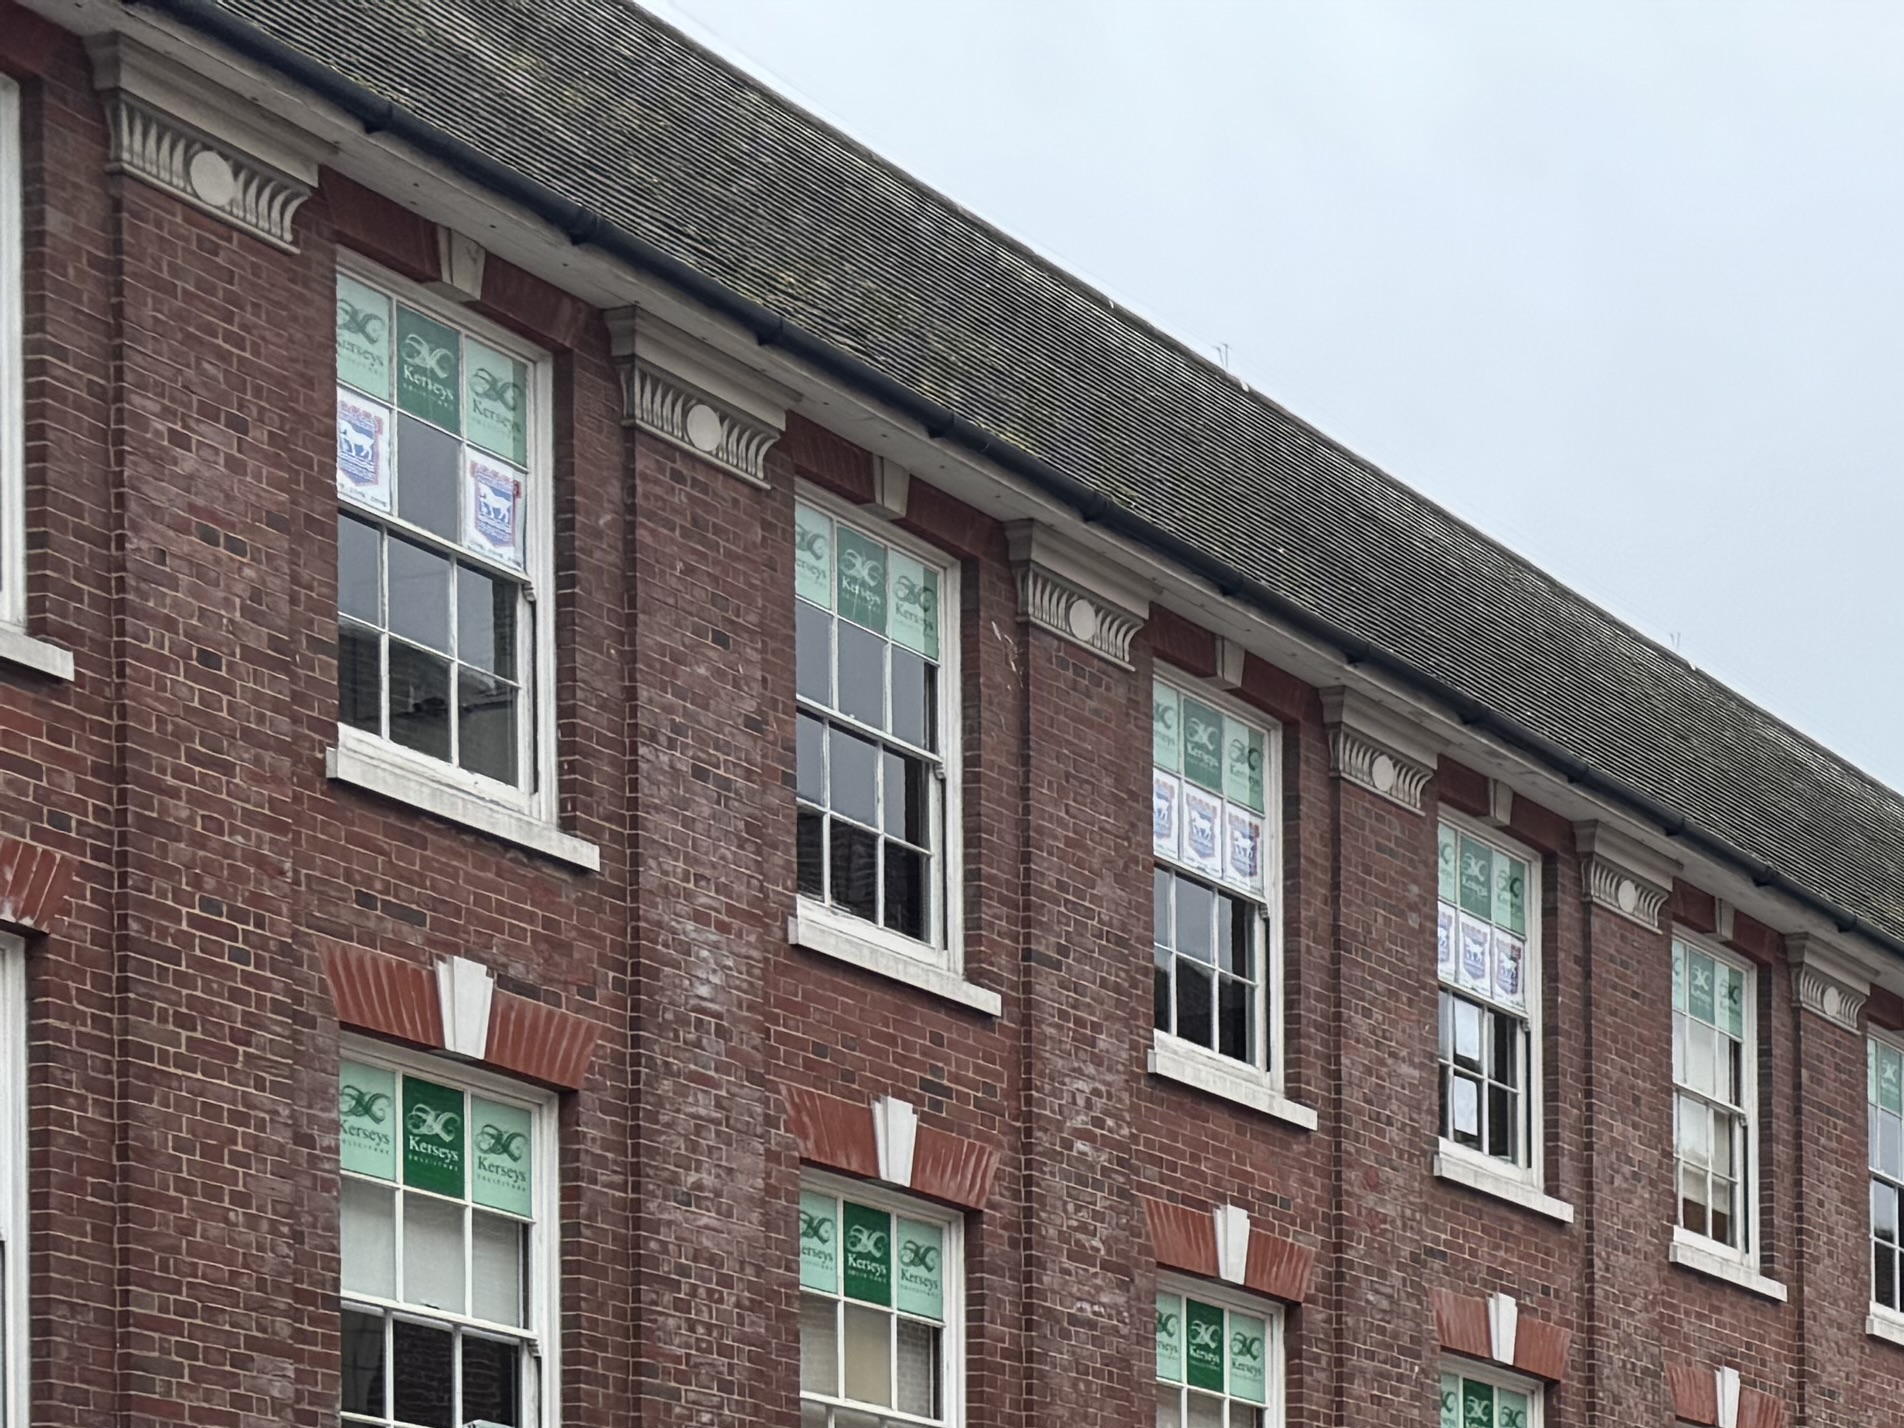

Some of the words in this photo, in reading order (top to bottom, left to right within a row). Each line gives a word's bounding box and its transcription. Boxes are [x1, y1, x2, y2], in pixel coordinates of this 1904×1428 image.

[403, 364, 454, 401] Kerseys
[409, 1135, 459, 1163] Kerseys
[478, 1156, 526, 1182] Kerseys
